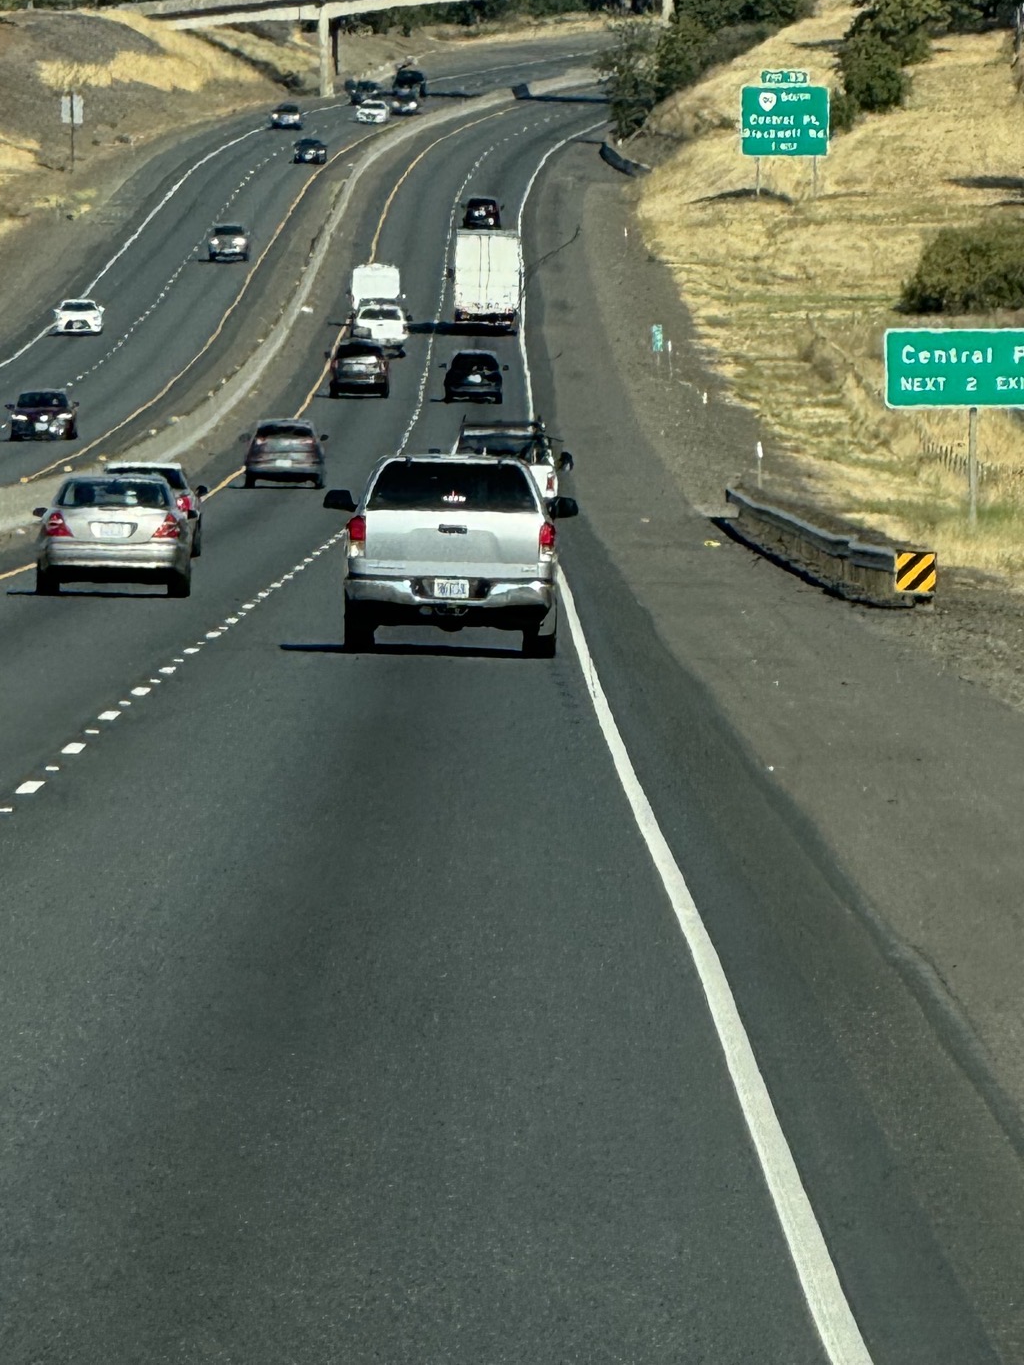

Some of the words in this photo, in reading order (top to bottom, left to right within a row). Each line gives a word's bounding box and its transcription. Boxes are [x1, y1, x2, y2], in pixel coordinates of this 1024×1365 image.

[901, 344, 993, 364] Central
[900, 376, 947, 391] NEXT
[965, 376, 978, 391] 2
